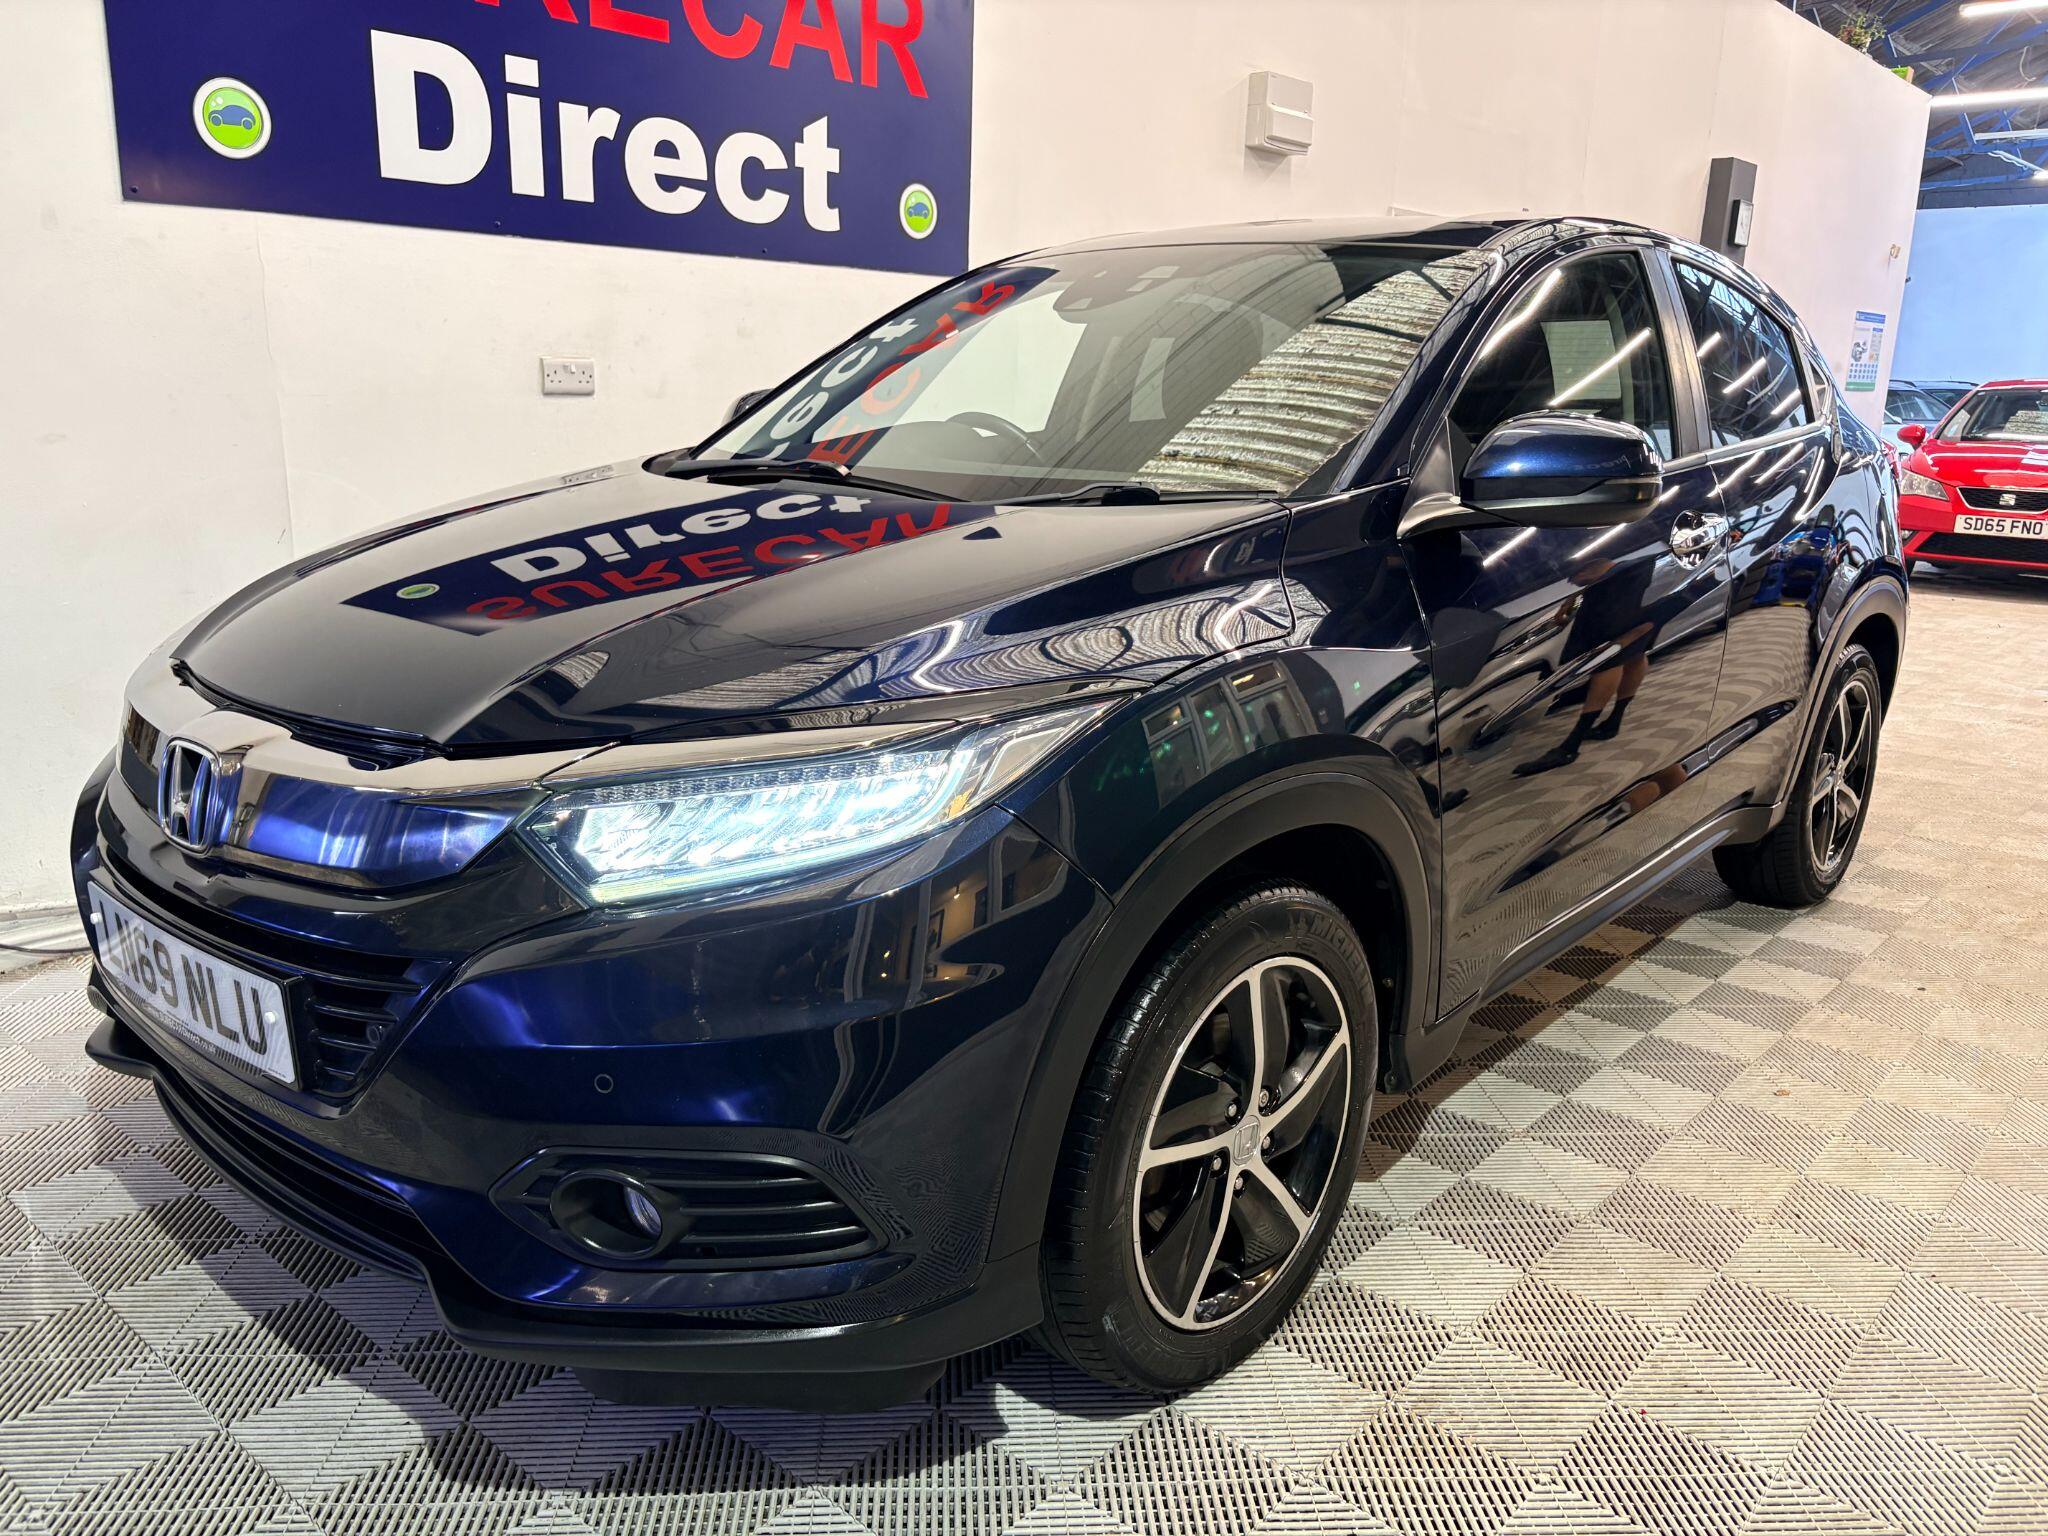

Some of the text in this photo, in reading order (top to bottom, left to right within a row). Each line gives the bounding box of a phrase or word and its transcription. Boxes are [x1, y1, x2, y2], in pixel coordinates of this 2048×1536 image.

[370, 29, 841, 232] Direct
[1963, 516, 2044, 536] SD65 FNO
[99, 899, 179, 1008] LN69
[181, 953, 267, 1056] NLU
